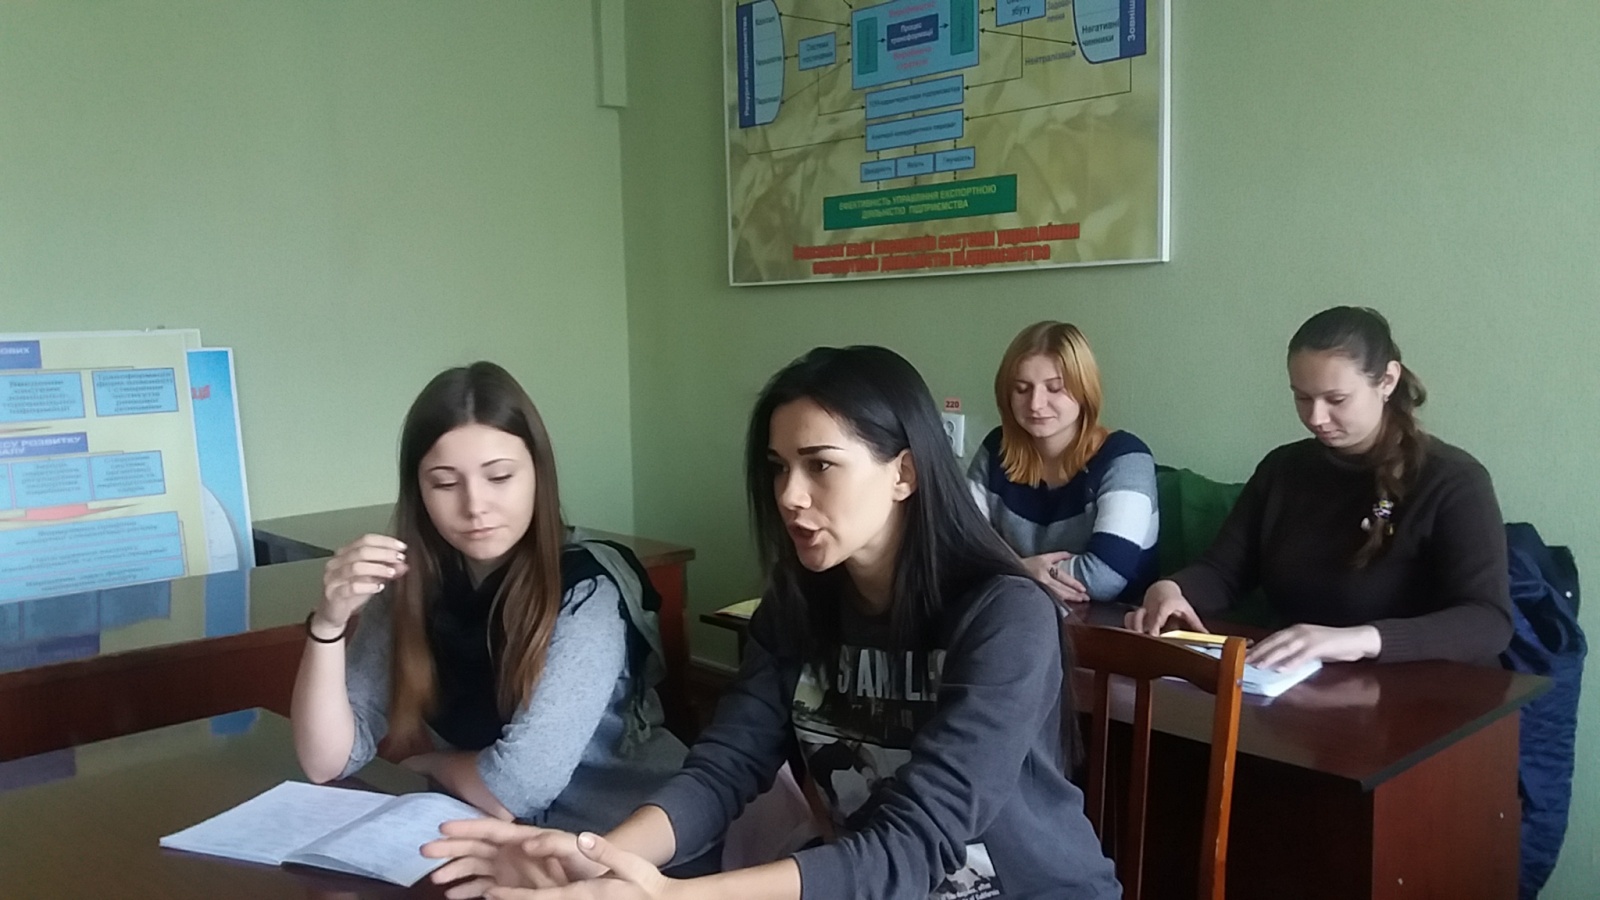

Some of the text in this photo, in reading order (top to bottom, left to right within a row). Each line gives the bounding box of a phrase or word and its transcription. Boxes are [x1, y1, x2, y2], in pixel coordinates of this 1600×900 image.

[940, 184, 997, 198] ЕКСПОРТНОЮ
[945, 400, 960, 409] 220
[21, 436, 81, 447] РОЗВИТКУ
